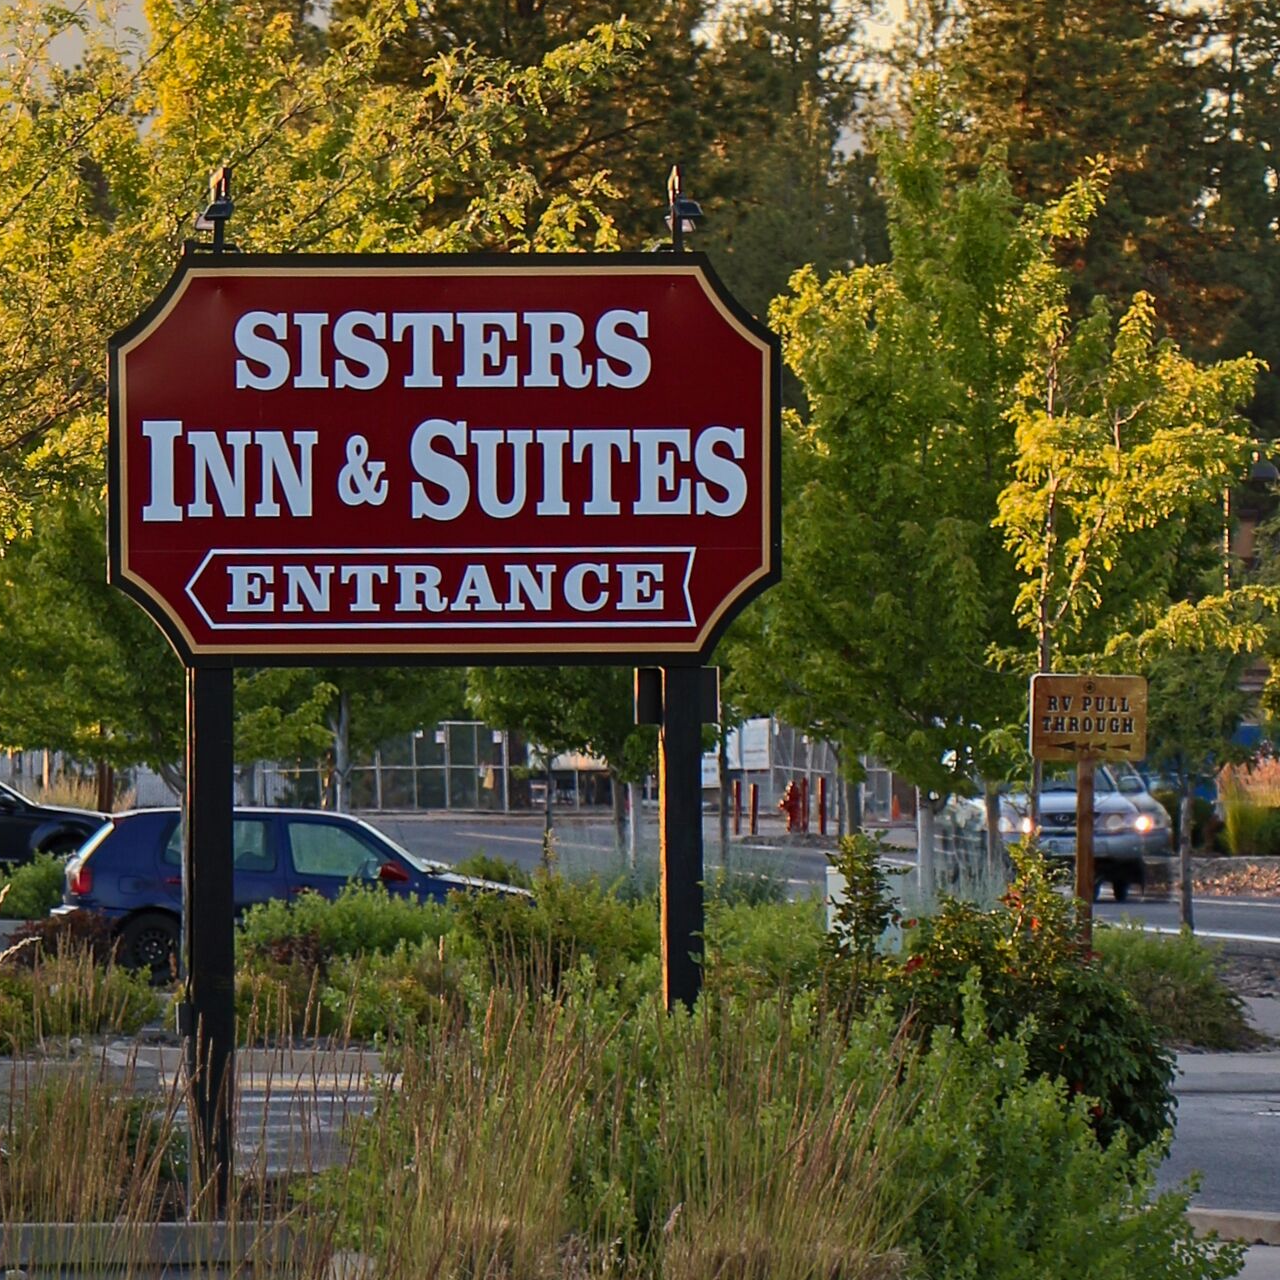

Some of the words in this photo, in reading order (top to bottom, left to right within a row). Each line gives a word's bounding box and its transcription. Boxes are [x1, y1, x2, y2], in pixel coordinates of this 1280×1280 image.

[233, 309, 652, 391] SISTERS
[336, 434, 389, 506] &
[225, 562, 665, 614] ENTRANCE
[1042, 717, 1134, 735] THROUGH
[1048, 696, 1072, 712] RV
[1082, 696, 1131, 713] PULL
